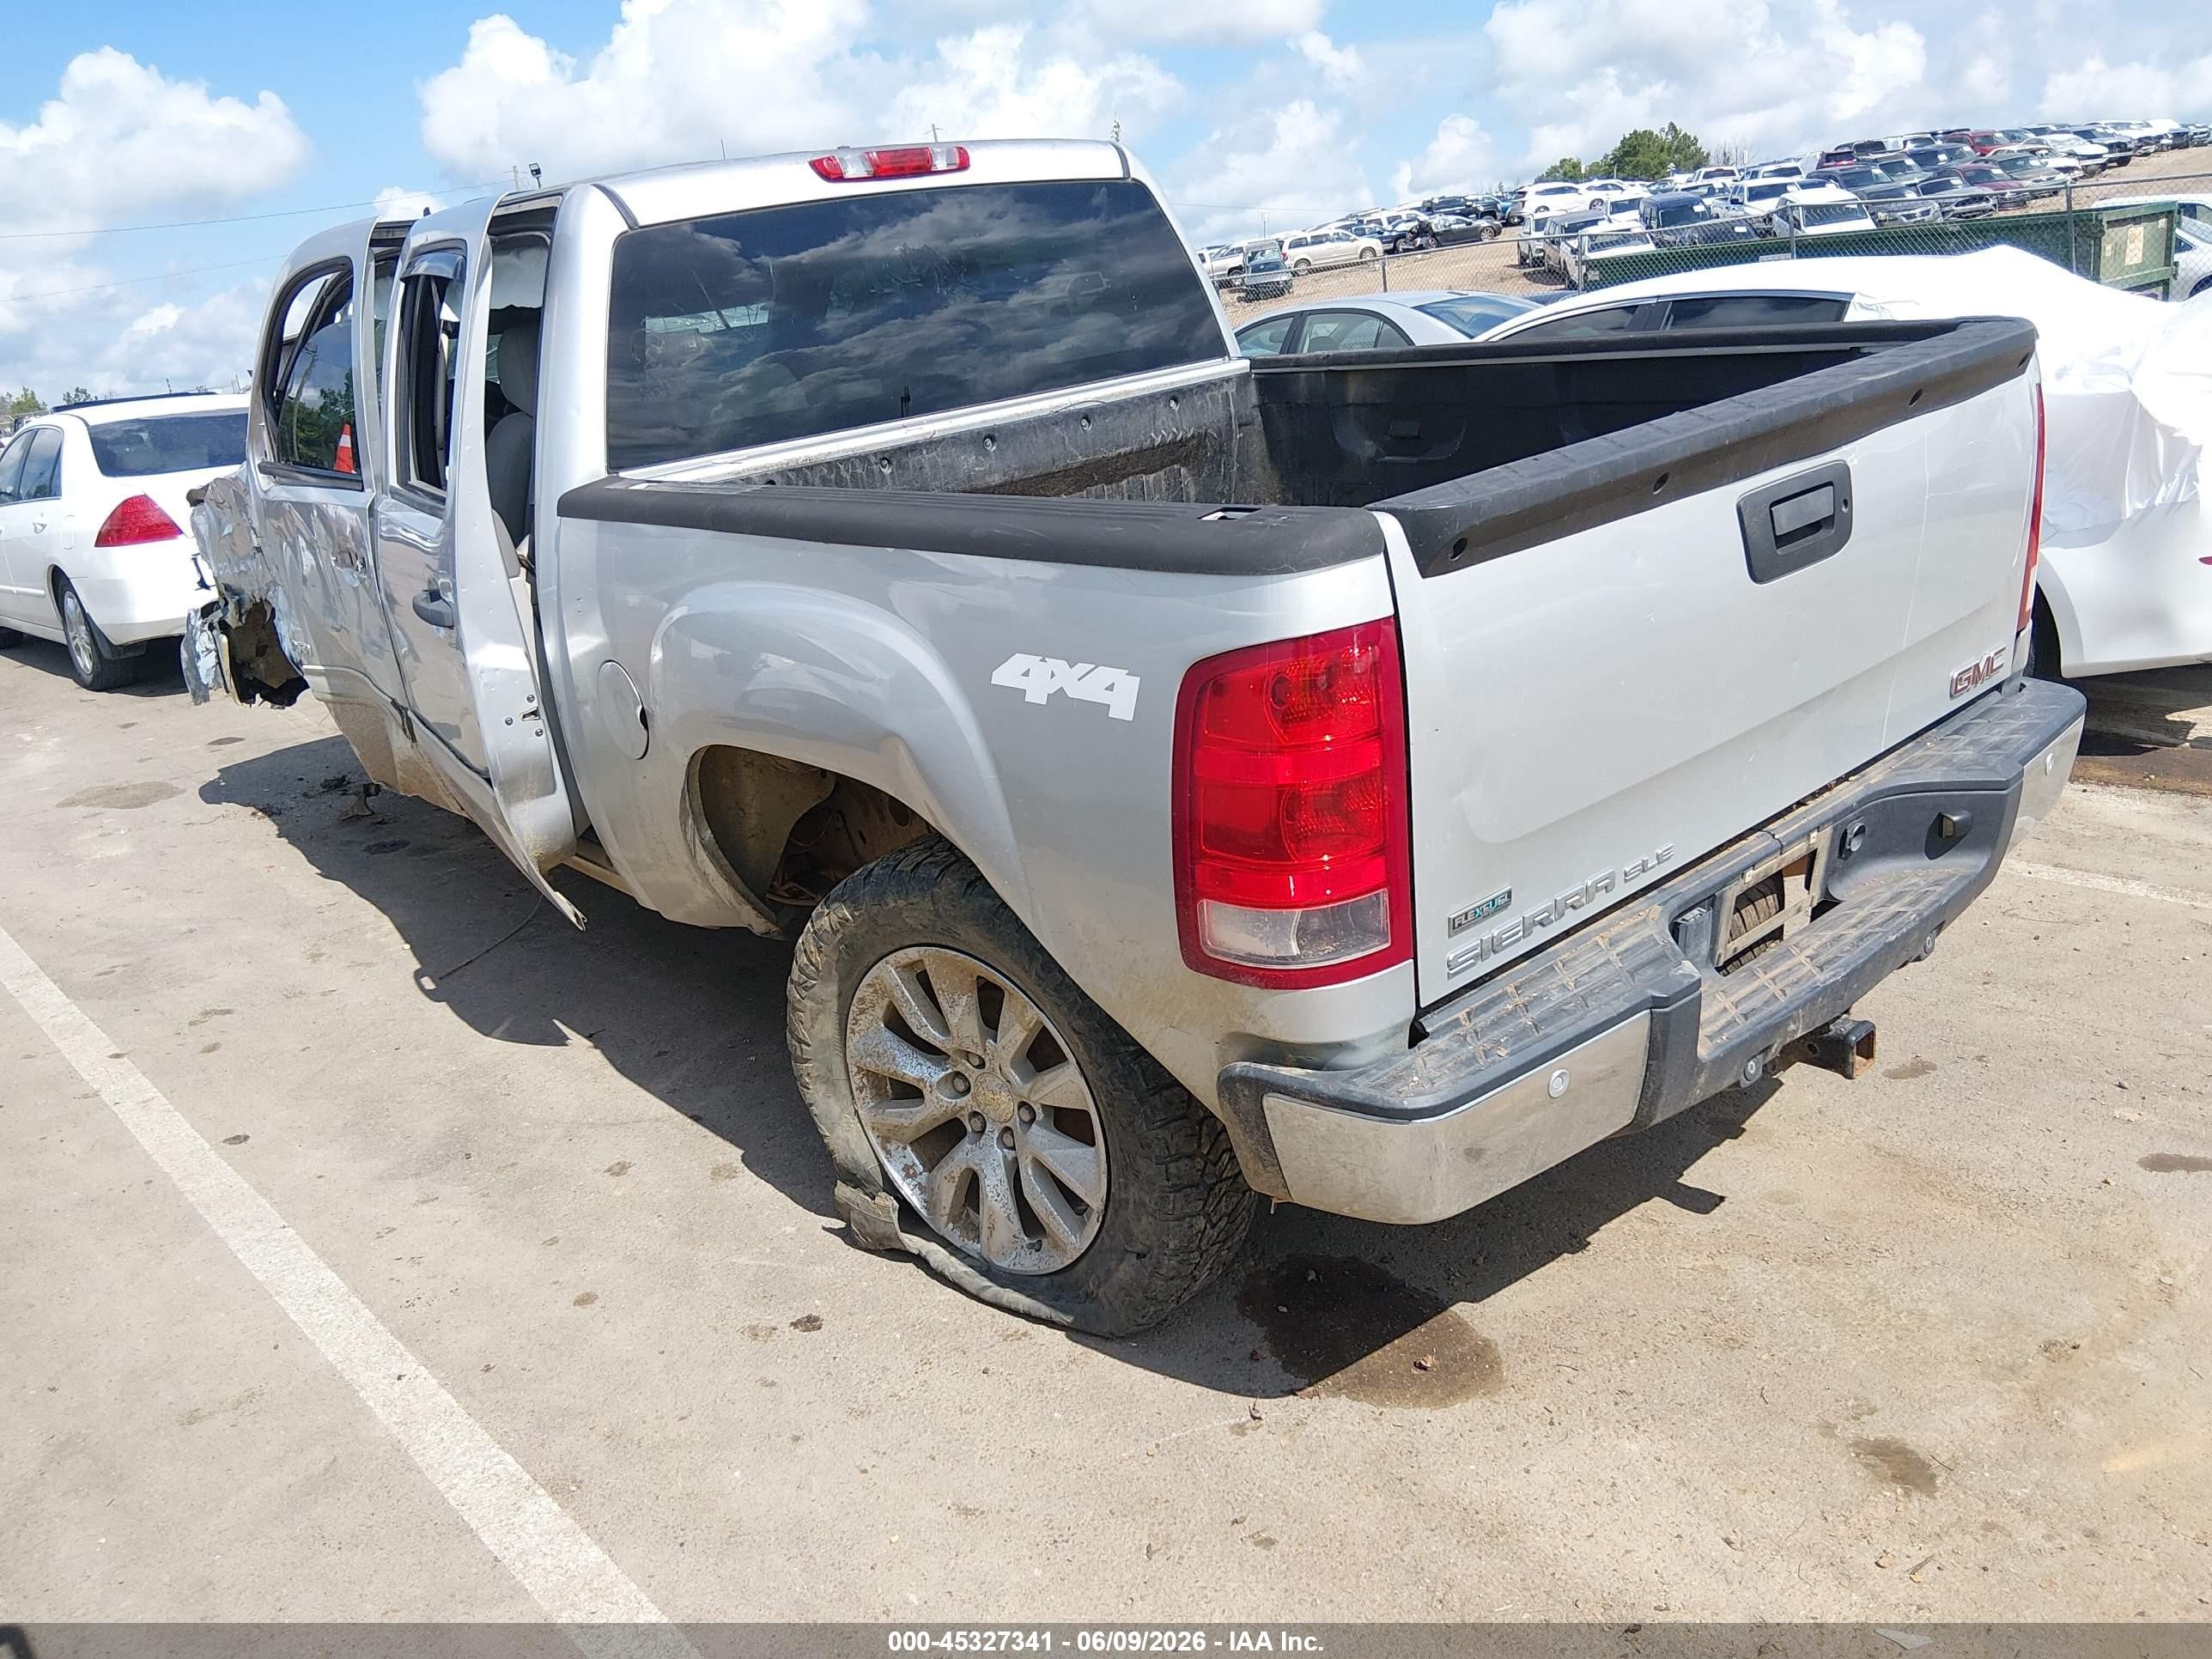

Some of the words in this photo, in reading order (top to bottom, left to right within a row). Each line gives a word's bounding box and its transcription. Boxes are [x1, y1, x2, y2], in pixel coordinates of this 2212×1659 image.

[991, 653, 1140, 721] 4X4
[1949, 645, 2006, 699] GMC
[1447, 867, 1616, 980] SIERRA
[1624, 843, 1674, 884] SLE
[1453, 891, 1511, 928] FLEXFUEL
